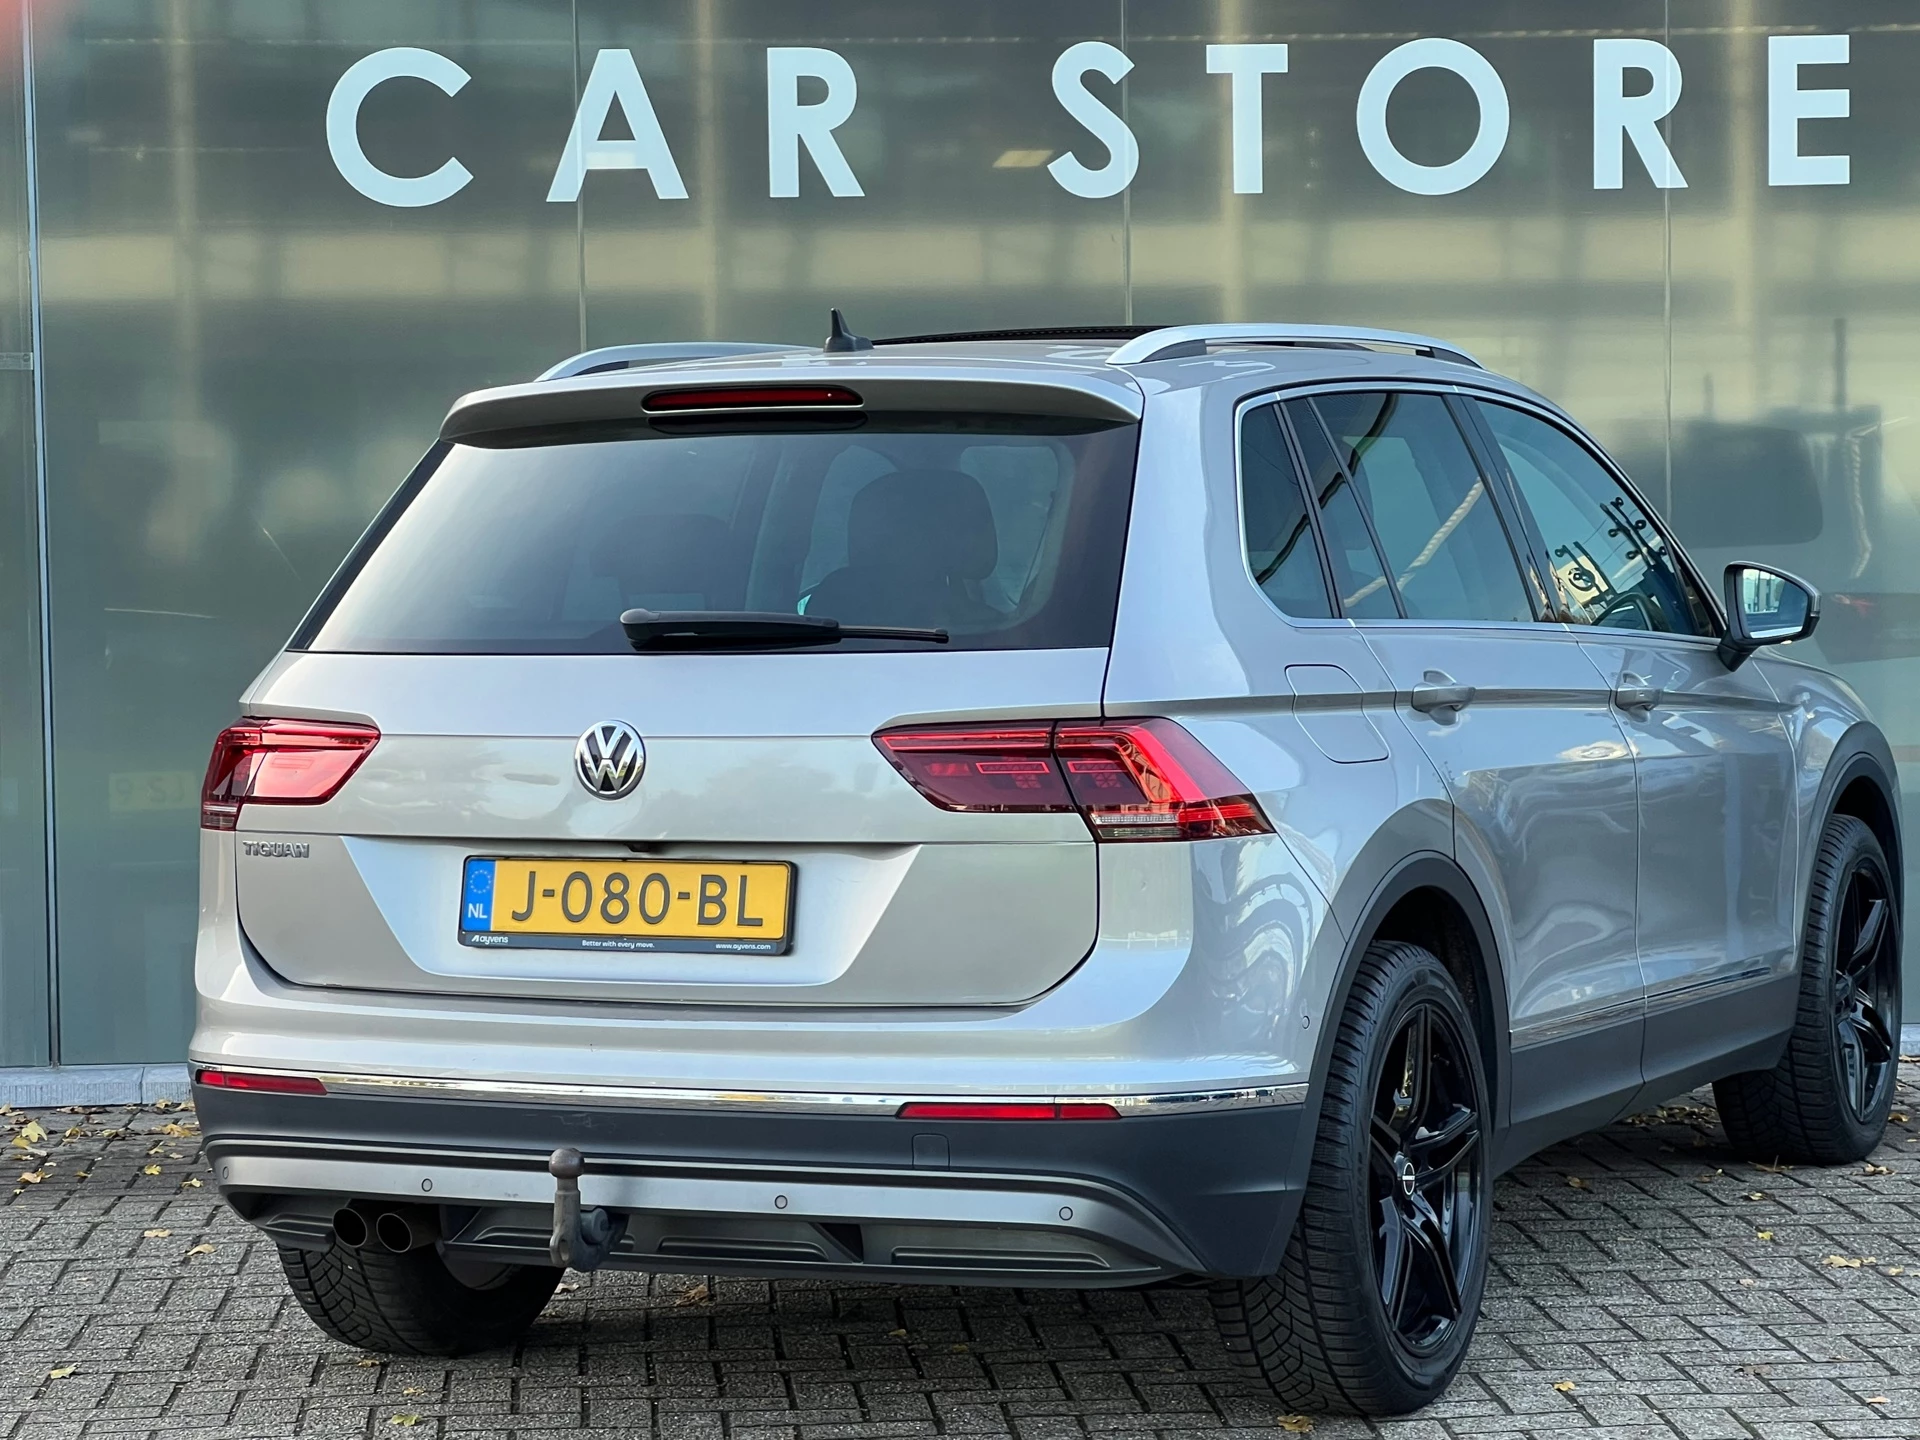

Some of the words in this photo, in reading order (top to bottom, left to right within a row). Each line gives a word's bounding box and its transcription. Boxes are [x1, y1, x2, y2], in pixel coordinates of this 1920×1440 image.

[326, 46, 866, 207] CAR
[1046, 34, 1851, 199] STORE
[242, 840, 310, 858] TIGUAN
[511, 870, 764, 927] J-080-BL
[468, 903, 488, 919] NL
[602, 940, 617, 948] with
[715, 943, 772, 951] www.ayvens.com
